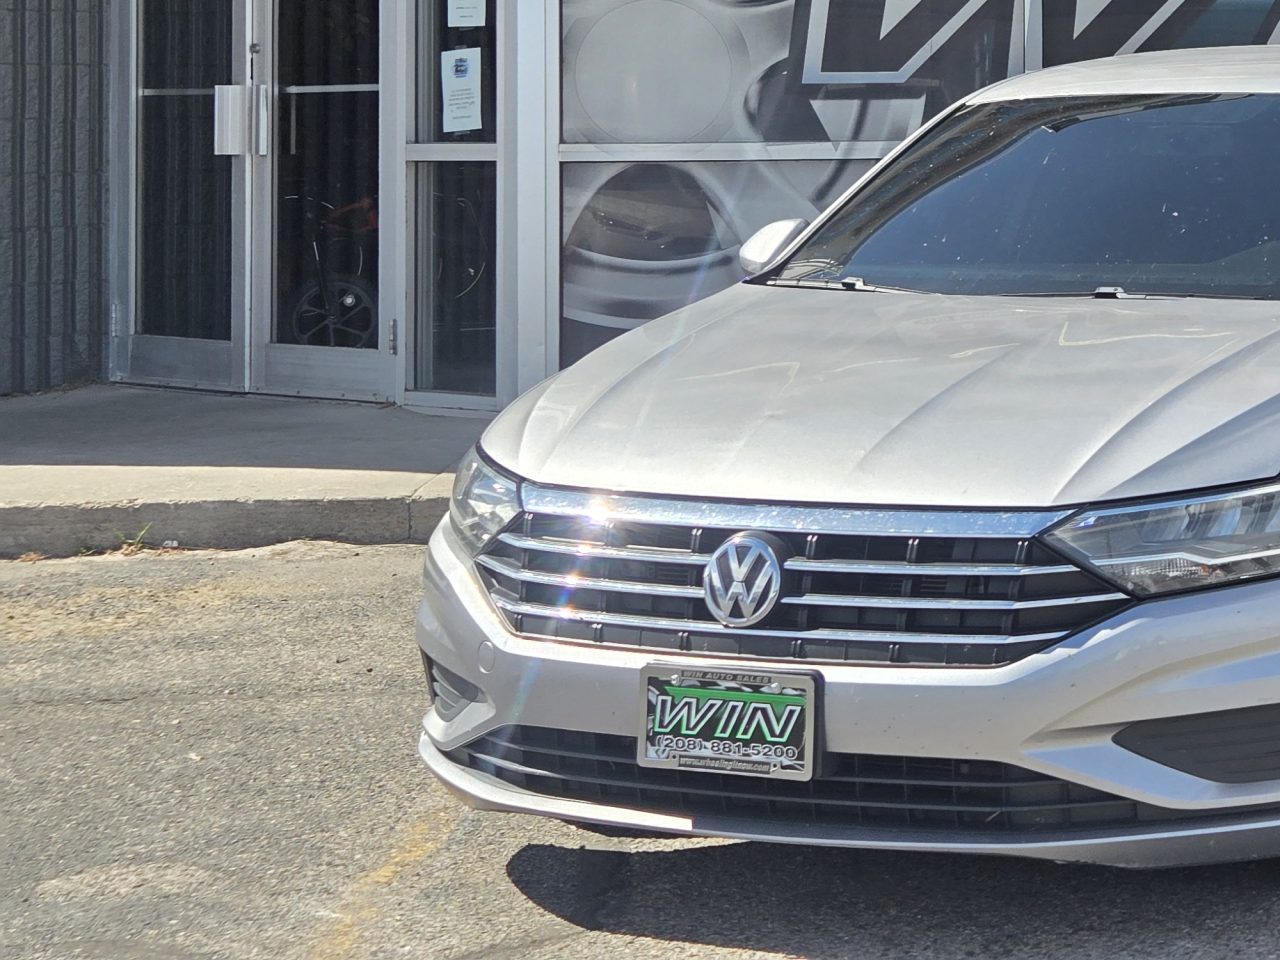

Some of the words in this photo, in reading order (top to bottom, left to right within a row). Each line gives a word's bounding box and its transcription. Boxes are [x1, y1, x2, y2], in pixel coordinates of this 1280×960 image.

[683, 671, 704, 680] WIN
[706, 672, 733, 682] AUTO
[736, 674, 770, 684] SALES
[654, 695, 802, 742] WIN
[710, 740, 798, 759] 881-5200
